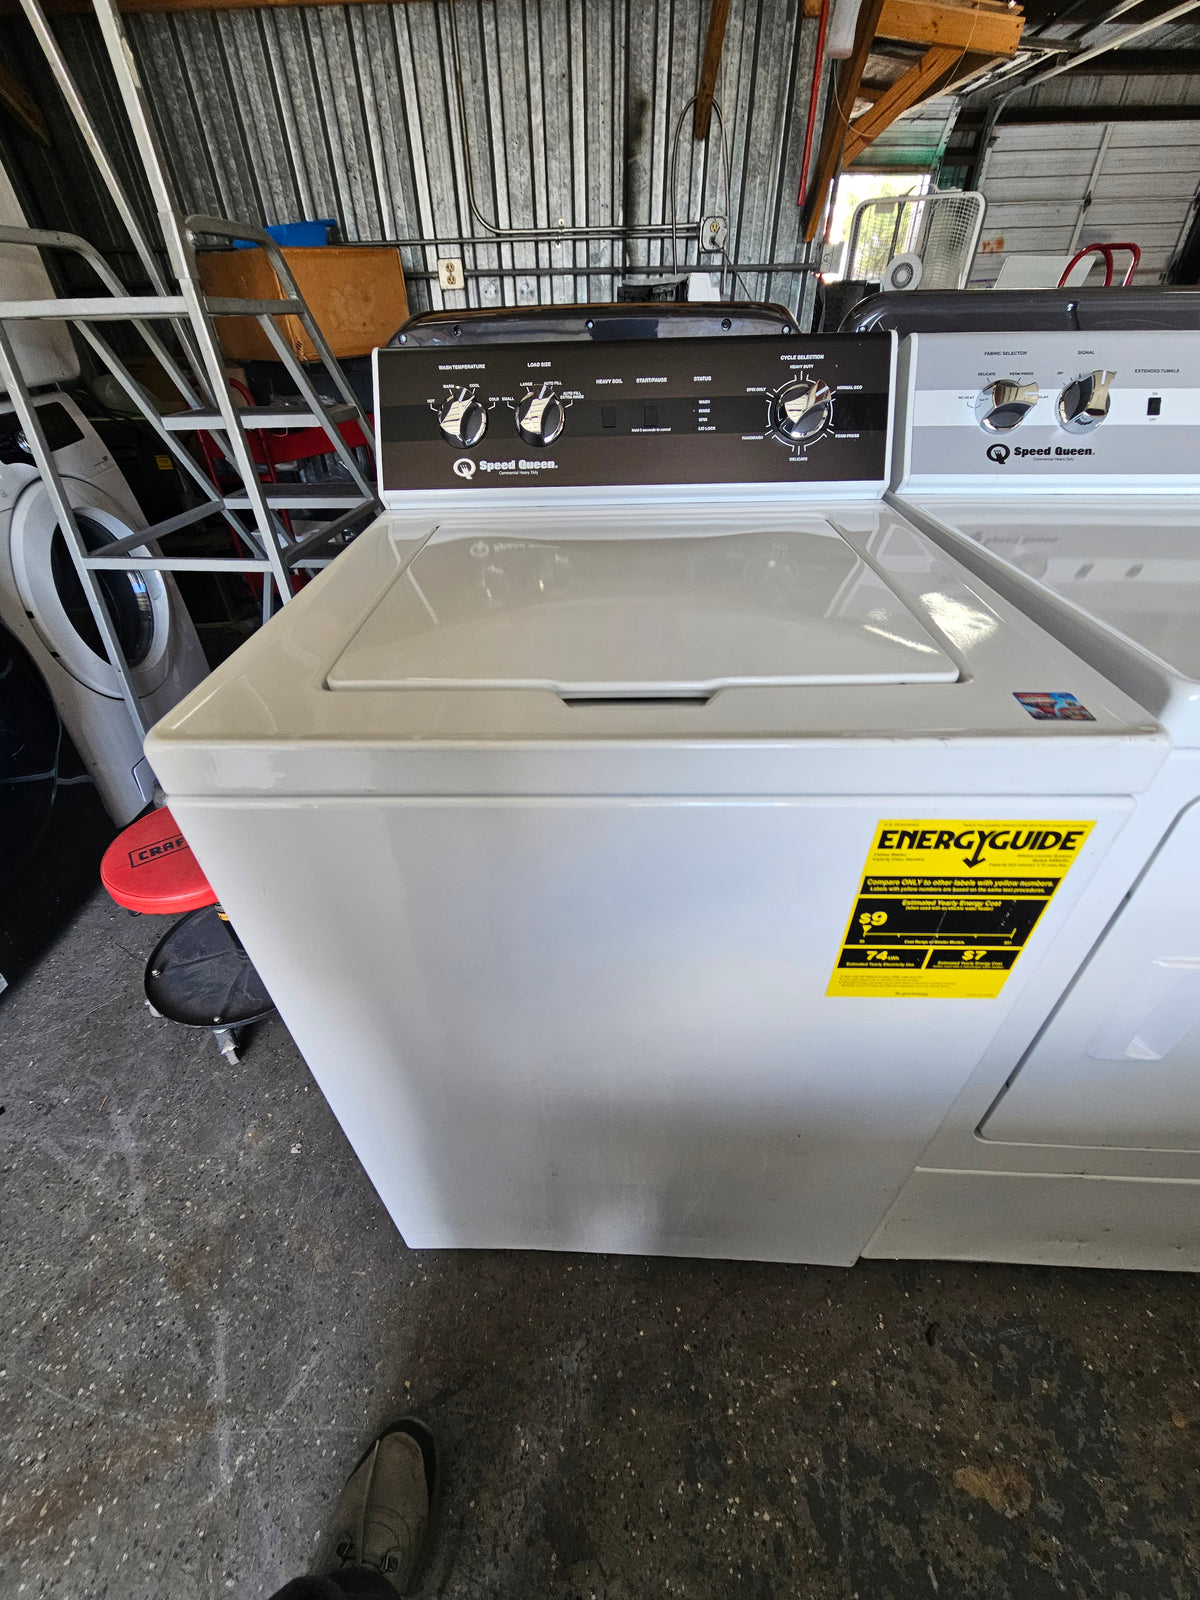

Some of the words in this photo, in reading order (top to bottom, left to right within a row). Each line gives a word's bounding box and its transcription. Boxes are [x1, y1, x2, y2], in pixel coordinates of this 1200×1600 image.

[1014, 447, 1051, 457] Speed
[479, 460, 515, 472] Speed
[877, 830, 1084, 850] ENERGYGUIDE
[138, 838, 184, 860] CRAF
[867, 878, 900, 886] Compare
[859, 911, 888, 926] $9
[867, 950, 888, 960] 74
[962, 950, 987, 961] $7
